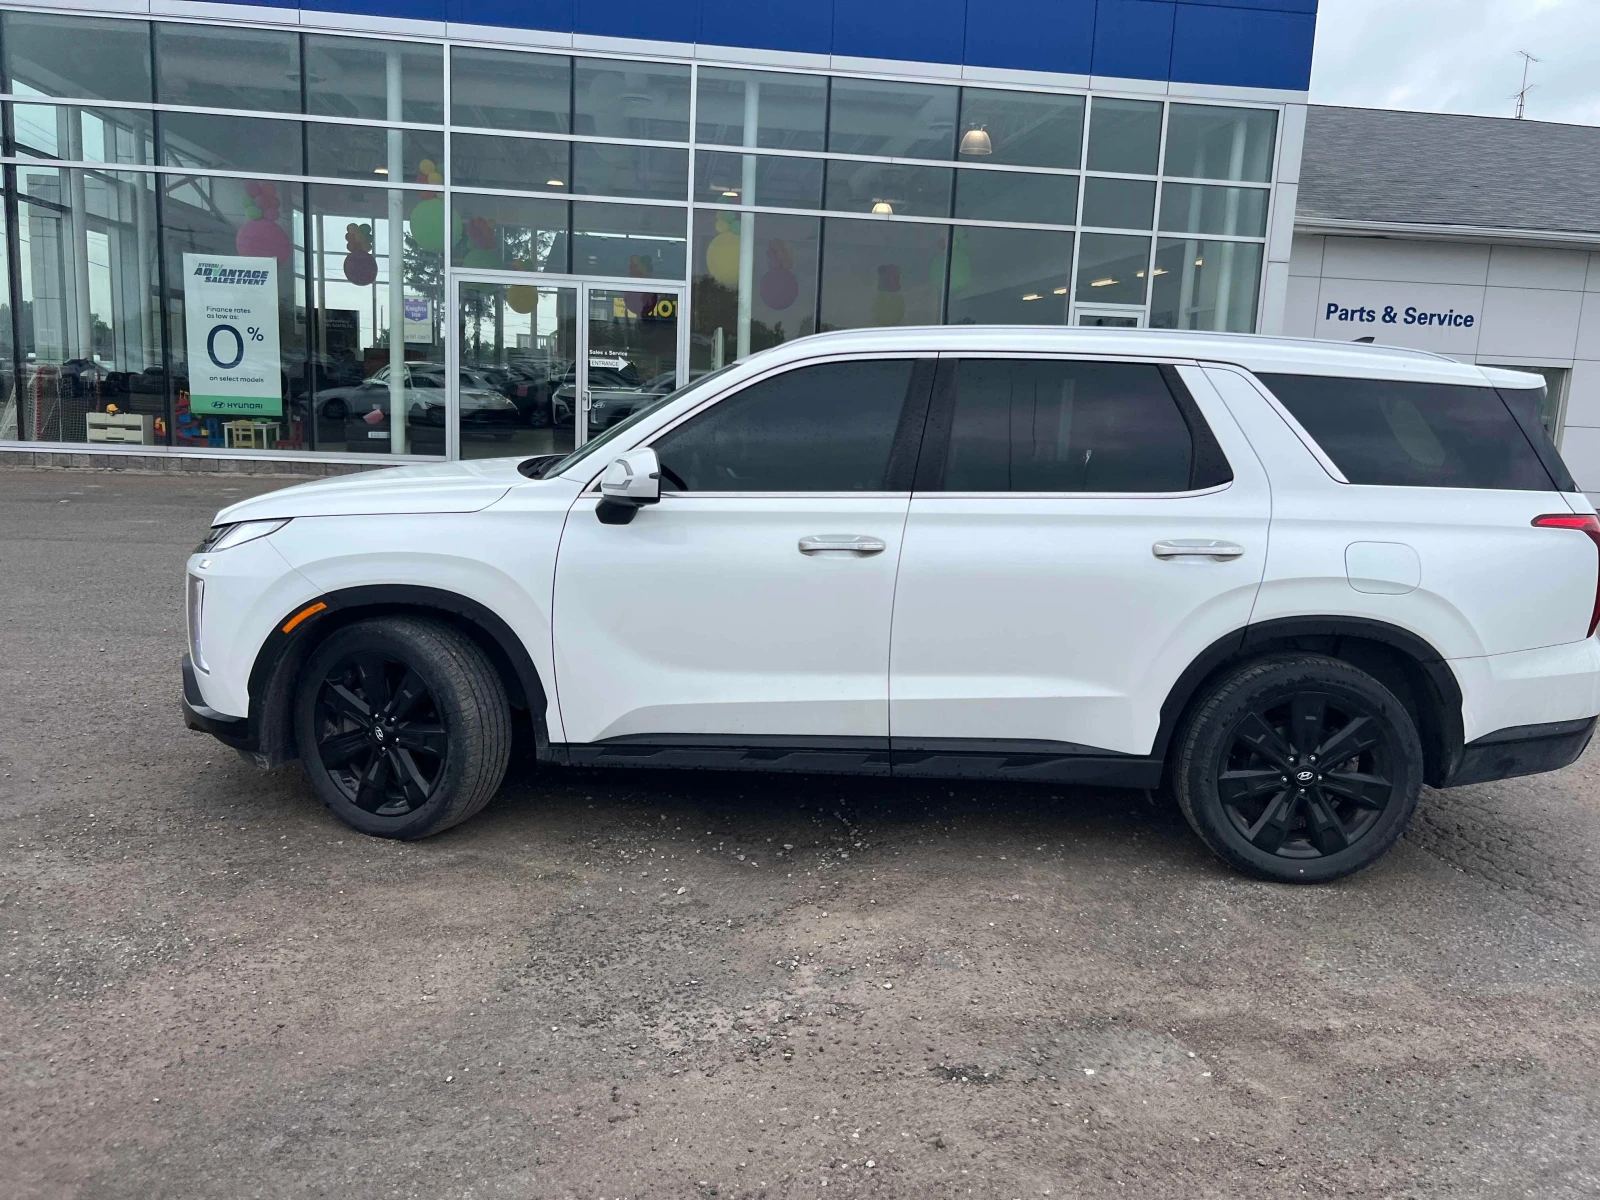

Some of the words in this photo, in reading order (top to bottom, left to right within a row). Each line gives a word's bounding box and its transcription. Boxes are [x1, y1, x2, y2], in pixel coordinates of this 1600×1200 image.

[194, 266, 269, 279] ADVANTAGE
[204, 277, 235, 285] SALES
[405, 305, 427, 313] Knights
[1326, 303, 1376, 323] Parts
[1381, 306, 1397, 324] &
[1403, 307, 1474, 328] Service
